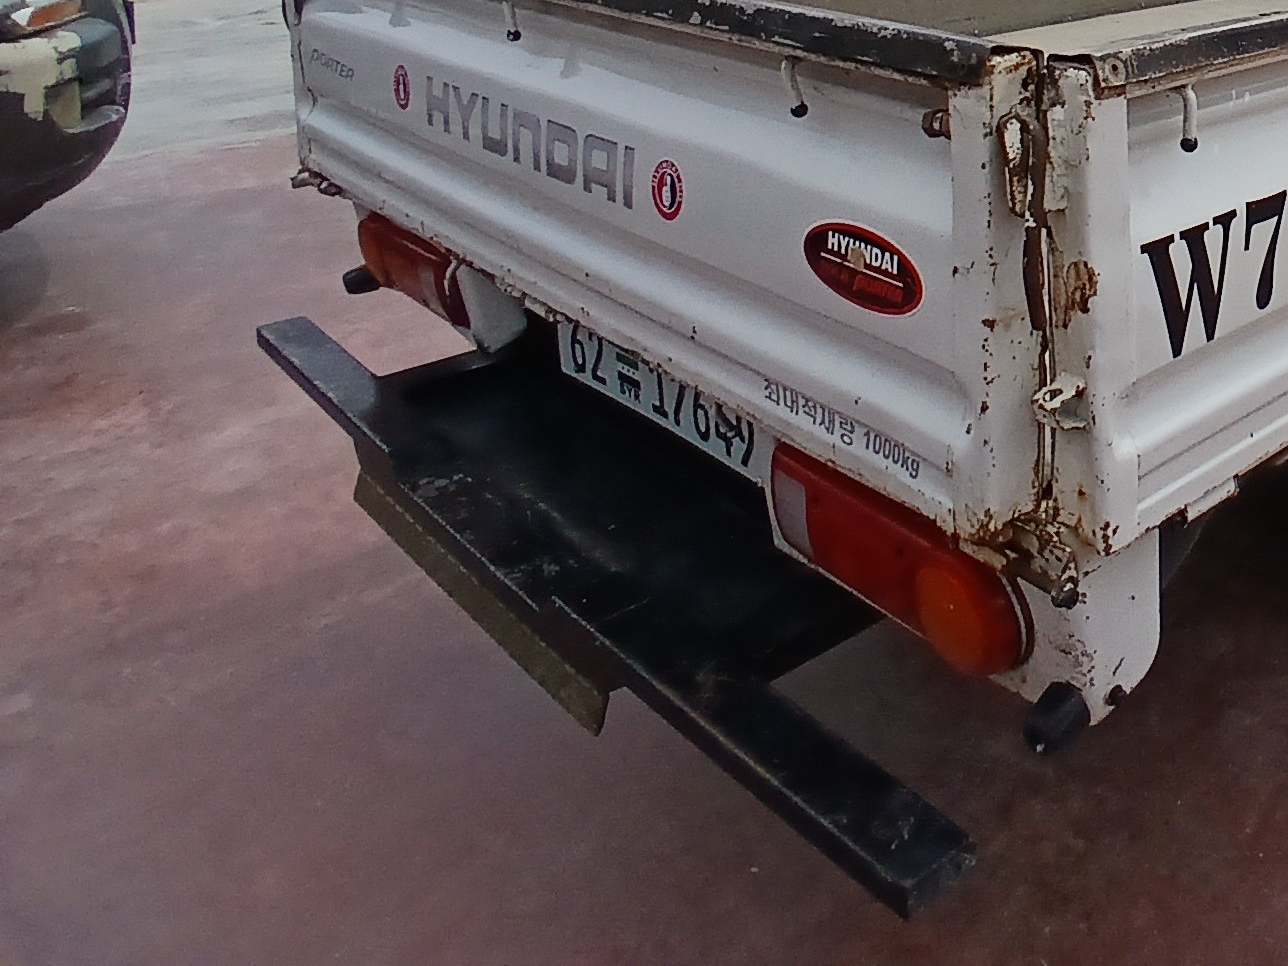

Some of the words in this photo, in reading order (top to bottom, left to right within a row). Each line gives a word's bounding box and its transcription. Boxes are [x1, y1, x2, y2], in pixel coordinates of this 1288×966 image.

[309, 48, 355, 81] PORTER
[426, 75, 635, 209] HYUNDAI
[570, 321, 607, 386] 62
[864, 429, 920, 480] 1000kg
